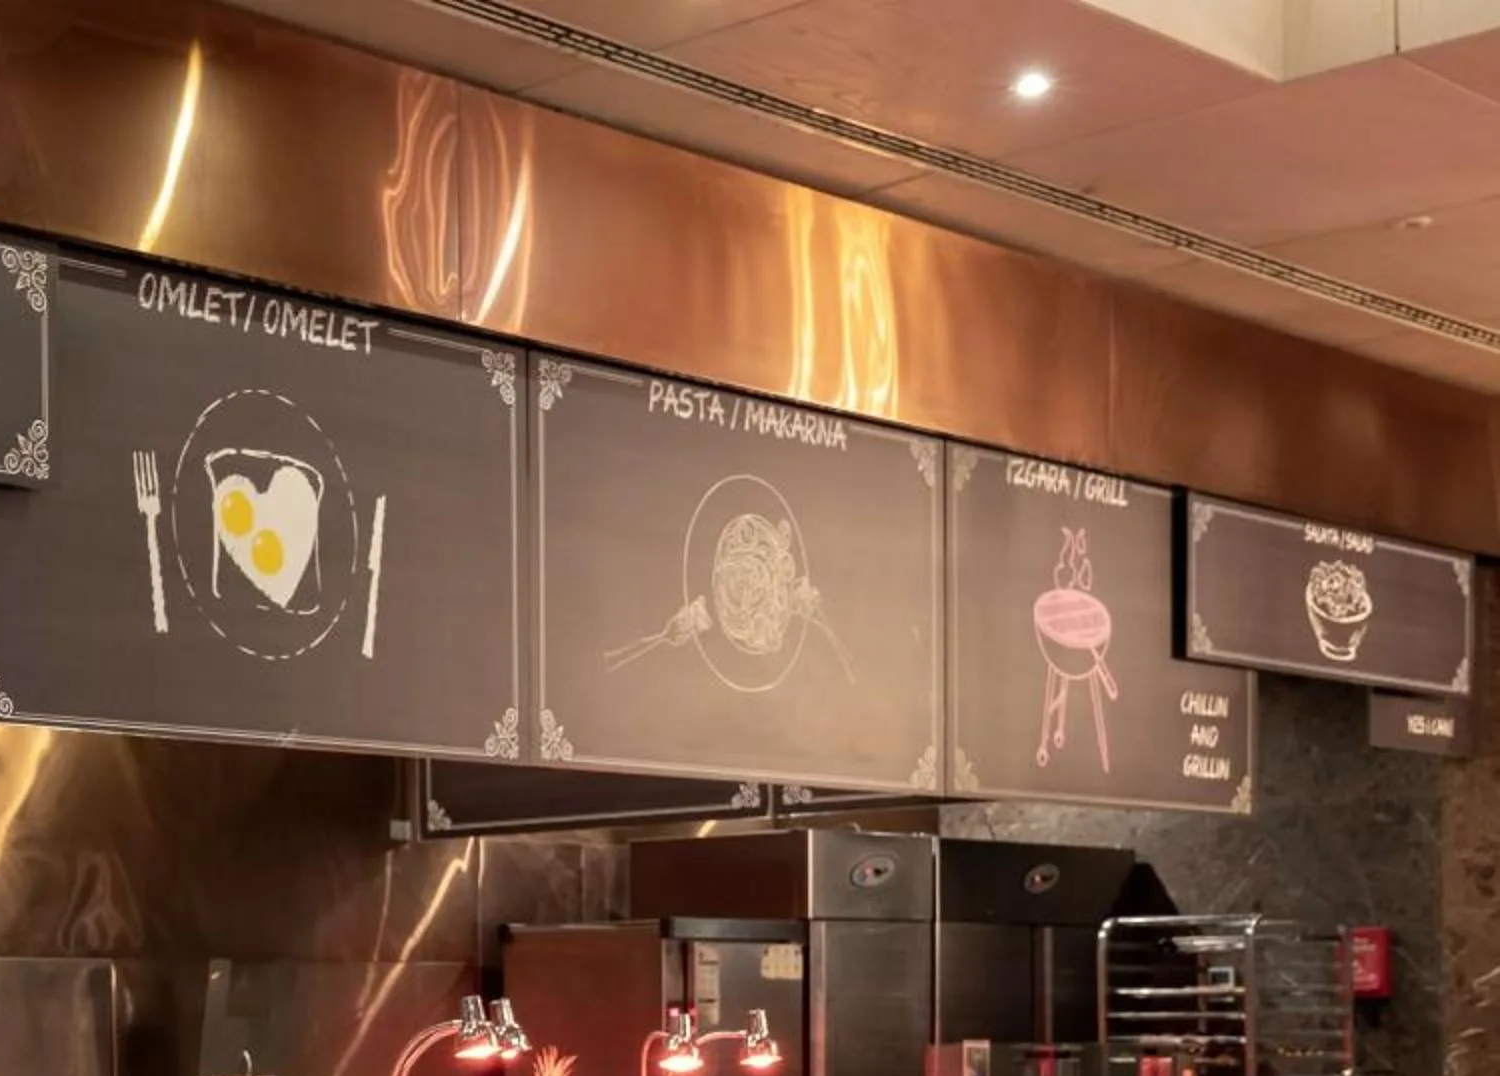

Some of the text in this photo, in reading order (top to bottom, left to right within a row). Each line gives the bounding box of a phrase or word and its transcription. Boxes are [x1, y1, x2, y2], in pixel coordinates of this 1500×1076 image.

[138, 272, 245, 326] OMLET
[263, 299, 379, 355] OMELET
[648, 380, 724, 427] PASTA
[744, 402, 847, 450] MAKARNA
[1084, 473, 1128, 506] GRILL
[1180, 692, 1229, 718] CHILLIN
[1190, 723, 1219, 748] AND
